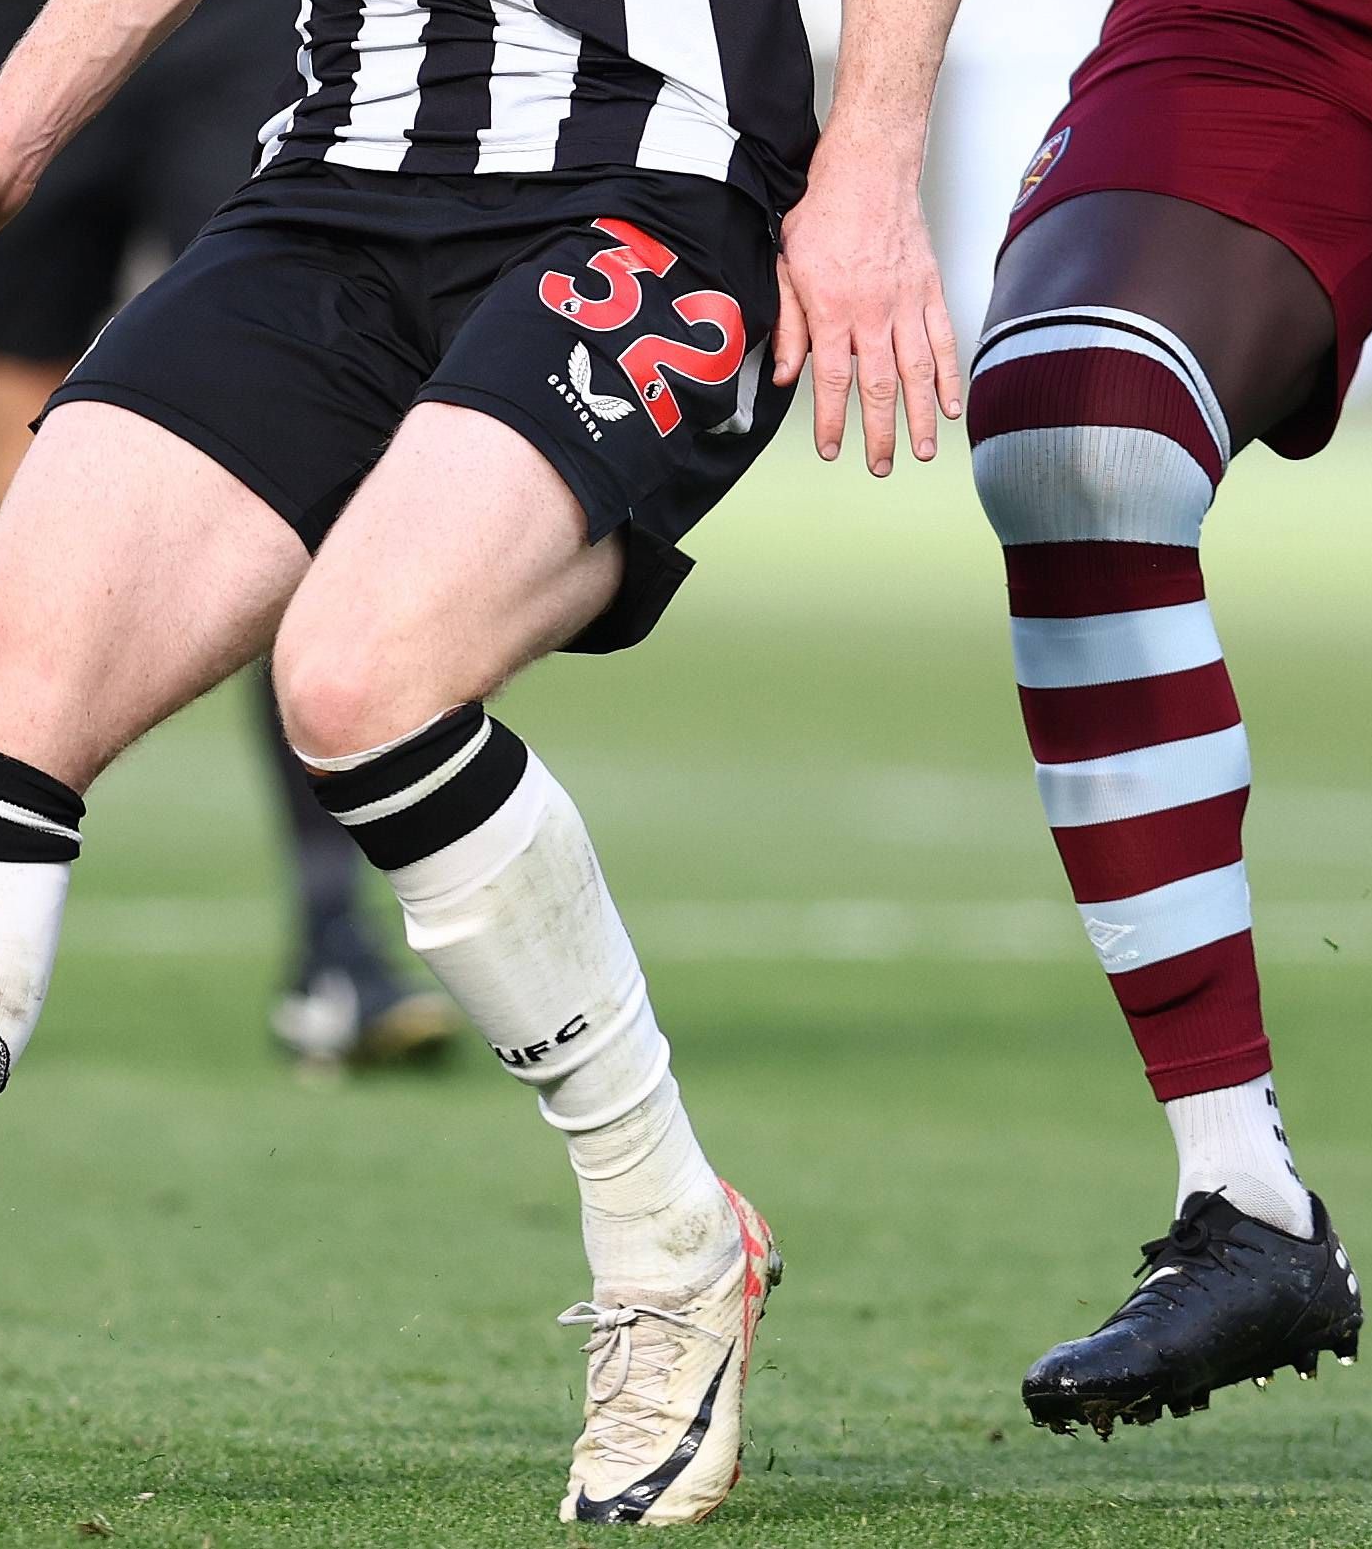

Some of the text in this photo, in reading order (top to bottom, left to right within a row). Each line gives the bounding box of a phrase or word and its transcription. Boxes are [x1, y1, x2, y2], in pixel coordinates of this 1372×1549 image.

[538, 217, 747, 438] 32
[547, 374, 603, 442] CASTORE
[488, 1013, 590, 1067] UFC
